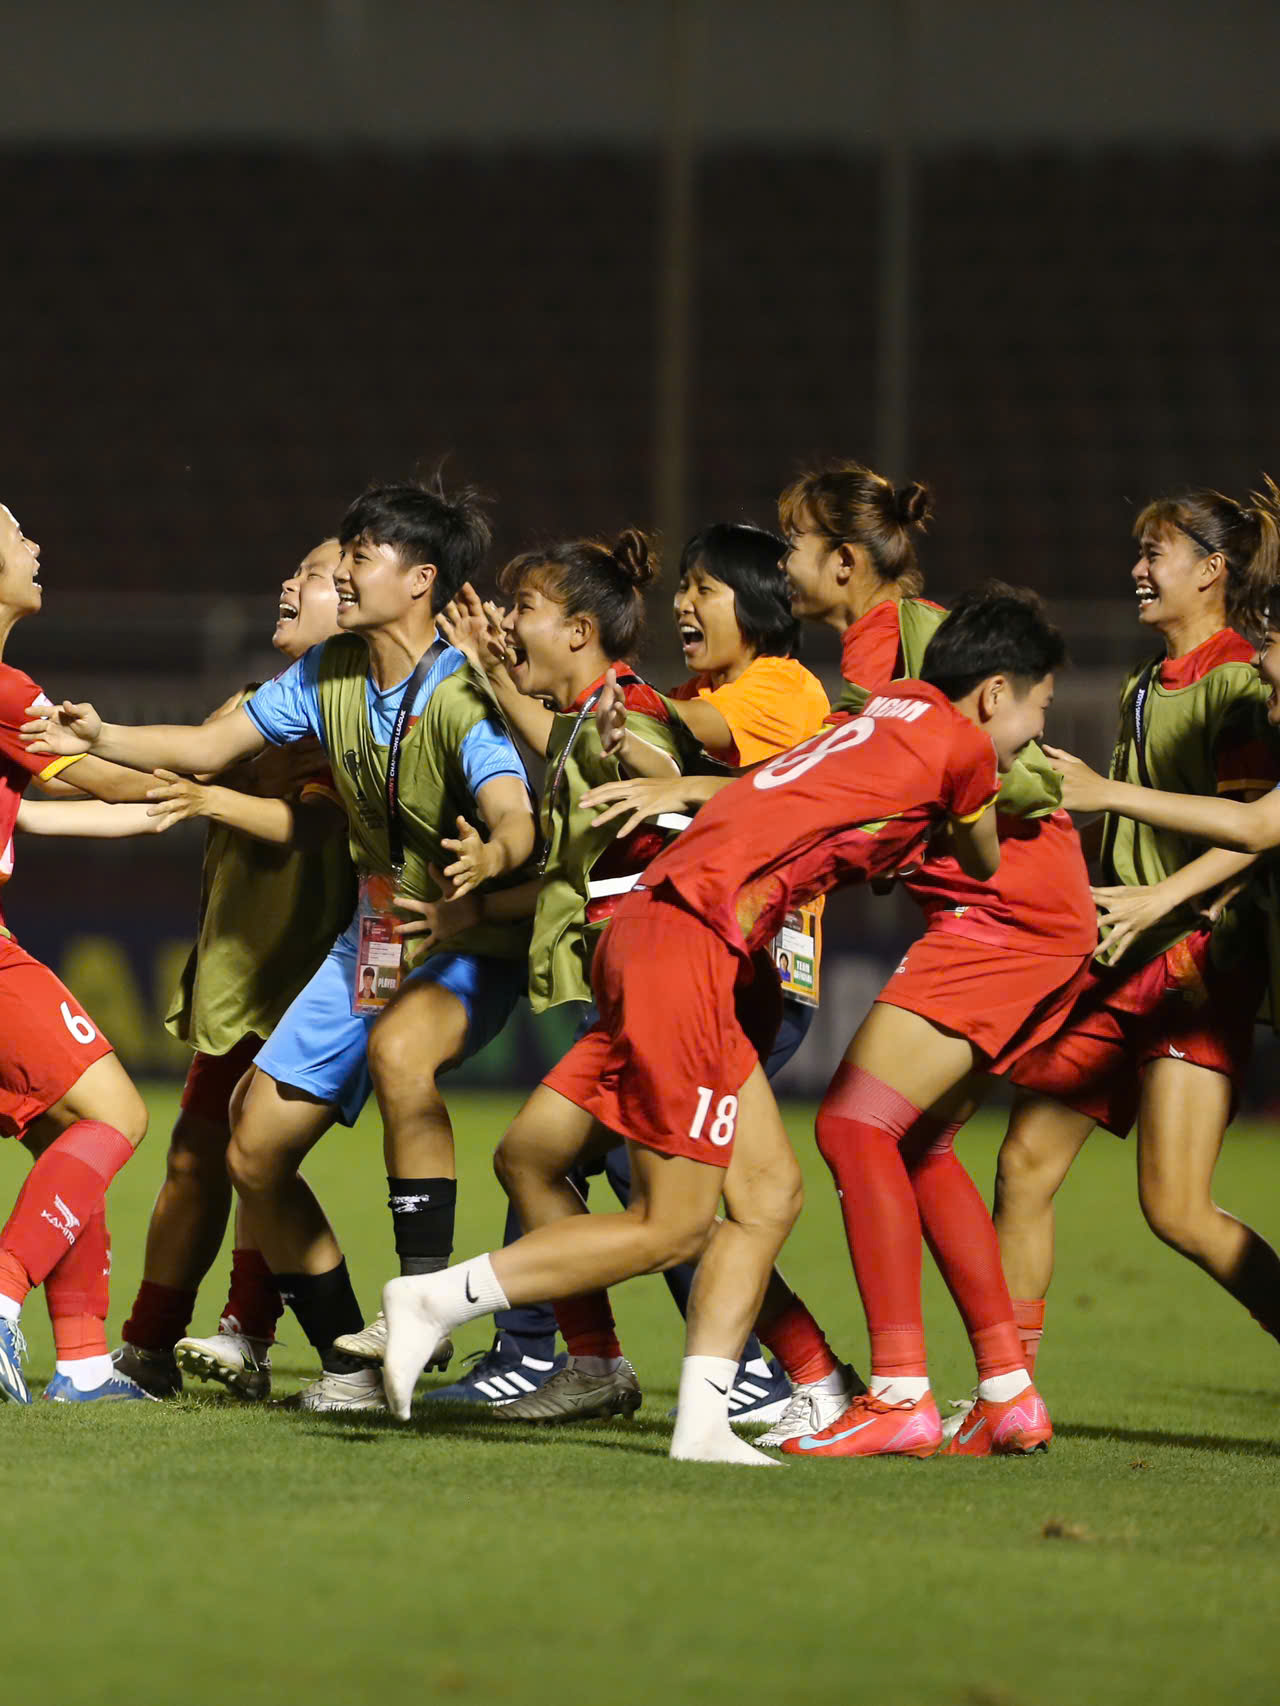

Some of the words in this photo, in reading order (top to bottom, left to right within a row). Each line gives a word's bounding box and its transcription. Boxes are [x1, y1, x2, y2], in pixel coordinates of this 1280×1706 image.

[394, 709, 407, 737] LEAGUE
[389, 736, 401, 777] CHAIONS
[60, 1001, 96, 1044] 6
[689, 1086, 738, 1146] 18
